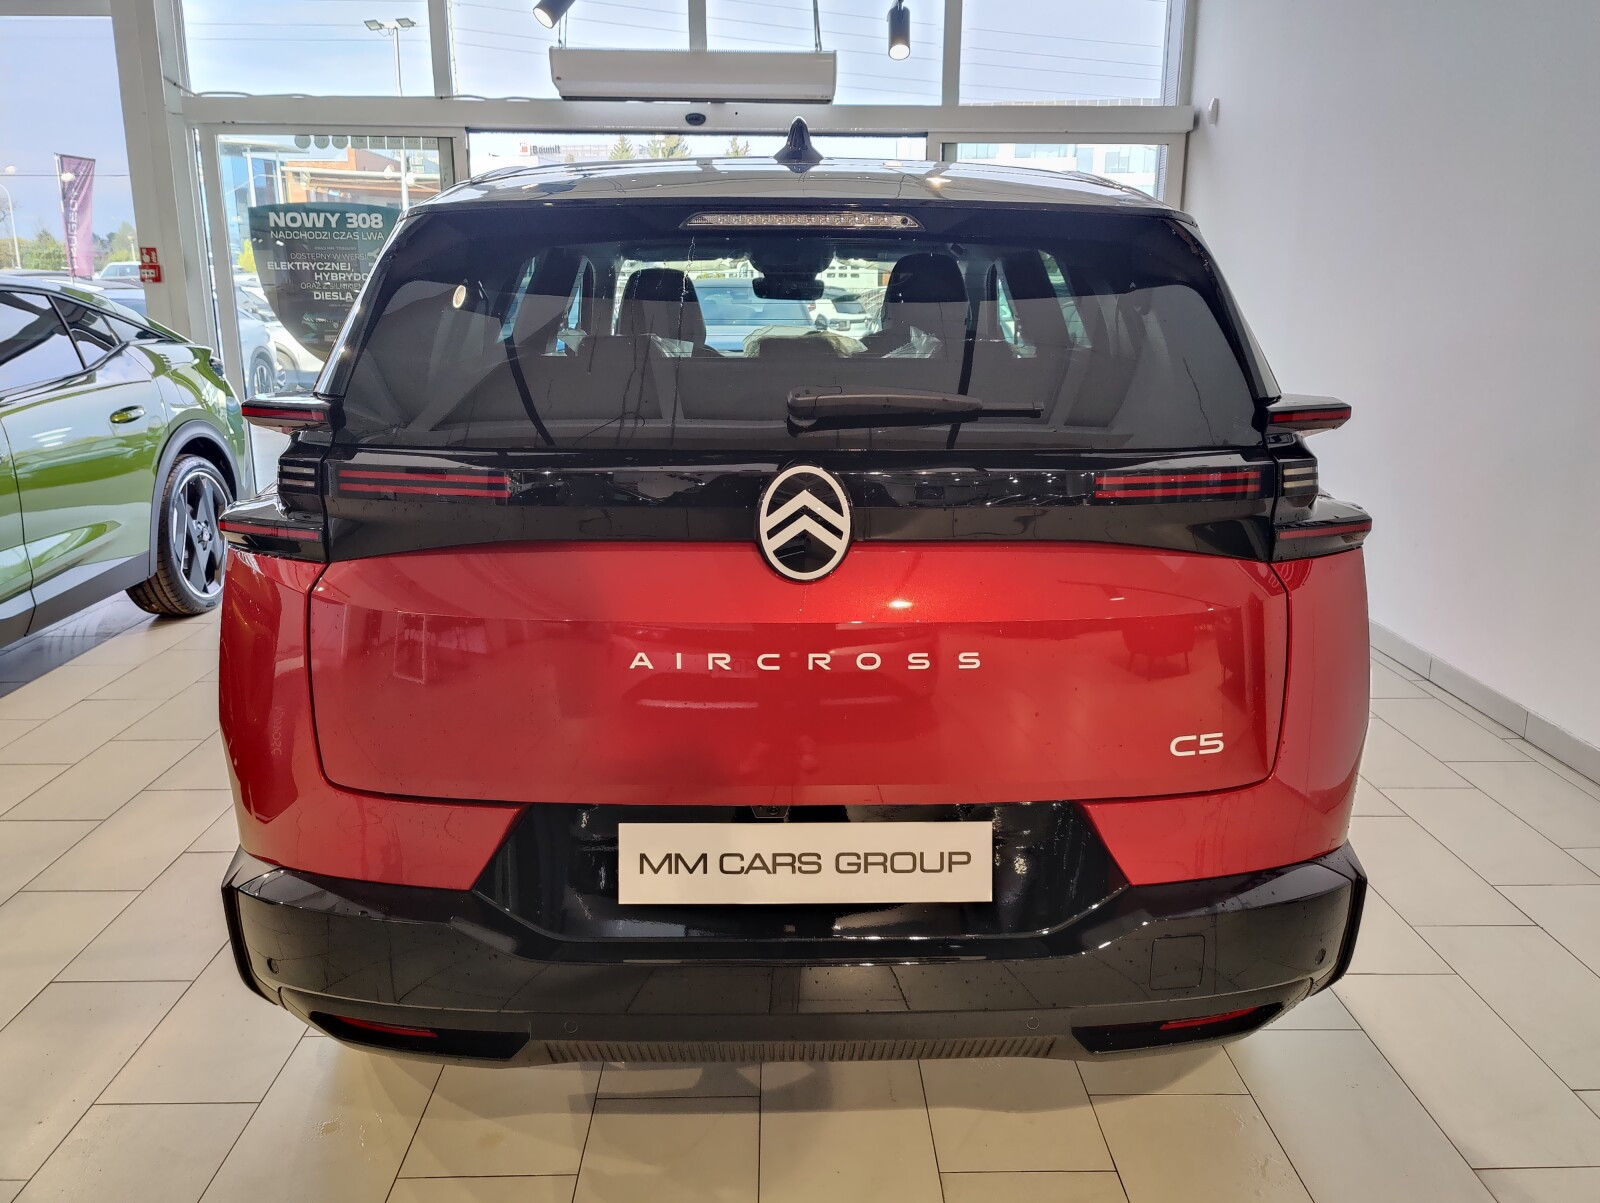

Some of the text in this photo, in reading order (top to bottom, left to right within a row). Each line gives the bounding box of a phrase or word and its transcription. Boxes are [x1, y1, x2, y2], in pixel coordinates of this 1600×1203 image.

[268, 211, 384, 229] NOWY 308
[270, 230, 385, 241] NADCHODZI CZAS LWA
[267, 261, 354, 272] ELEKTRYCZNEJ,
[313, 291, 354, 300] DIESLA
[629, 652, 981, 671] AIRCROSS
[1169, 732, 1225, 757] C5
[639, 851, 972, 875] MM CARS GROUP
